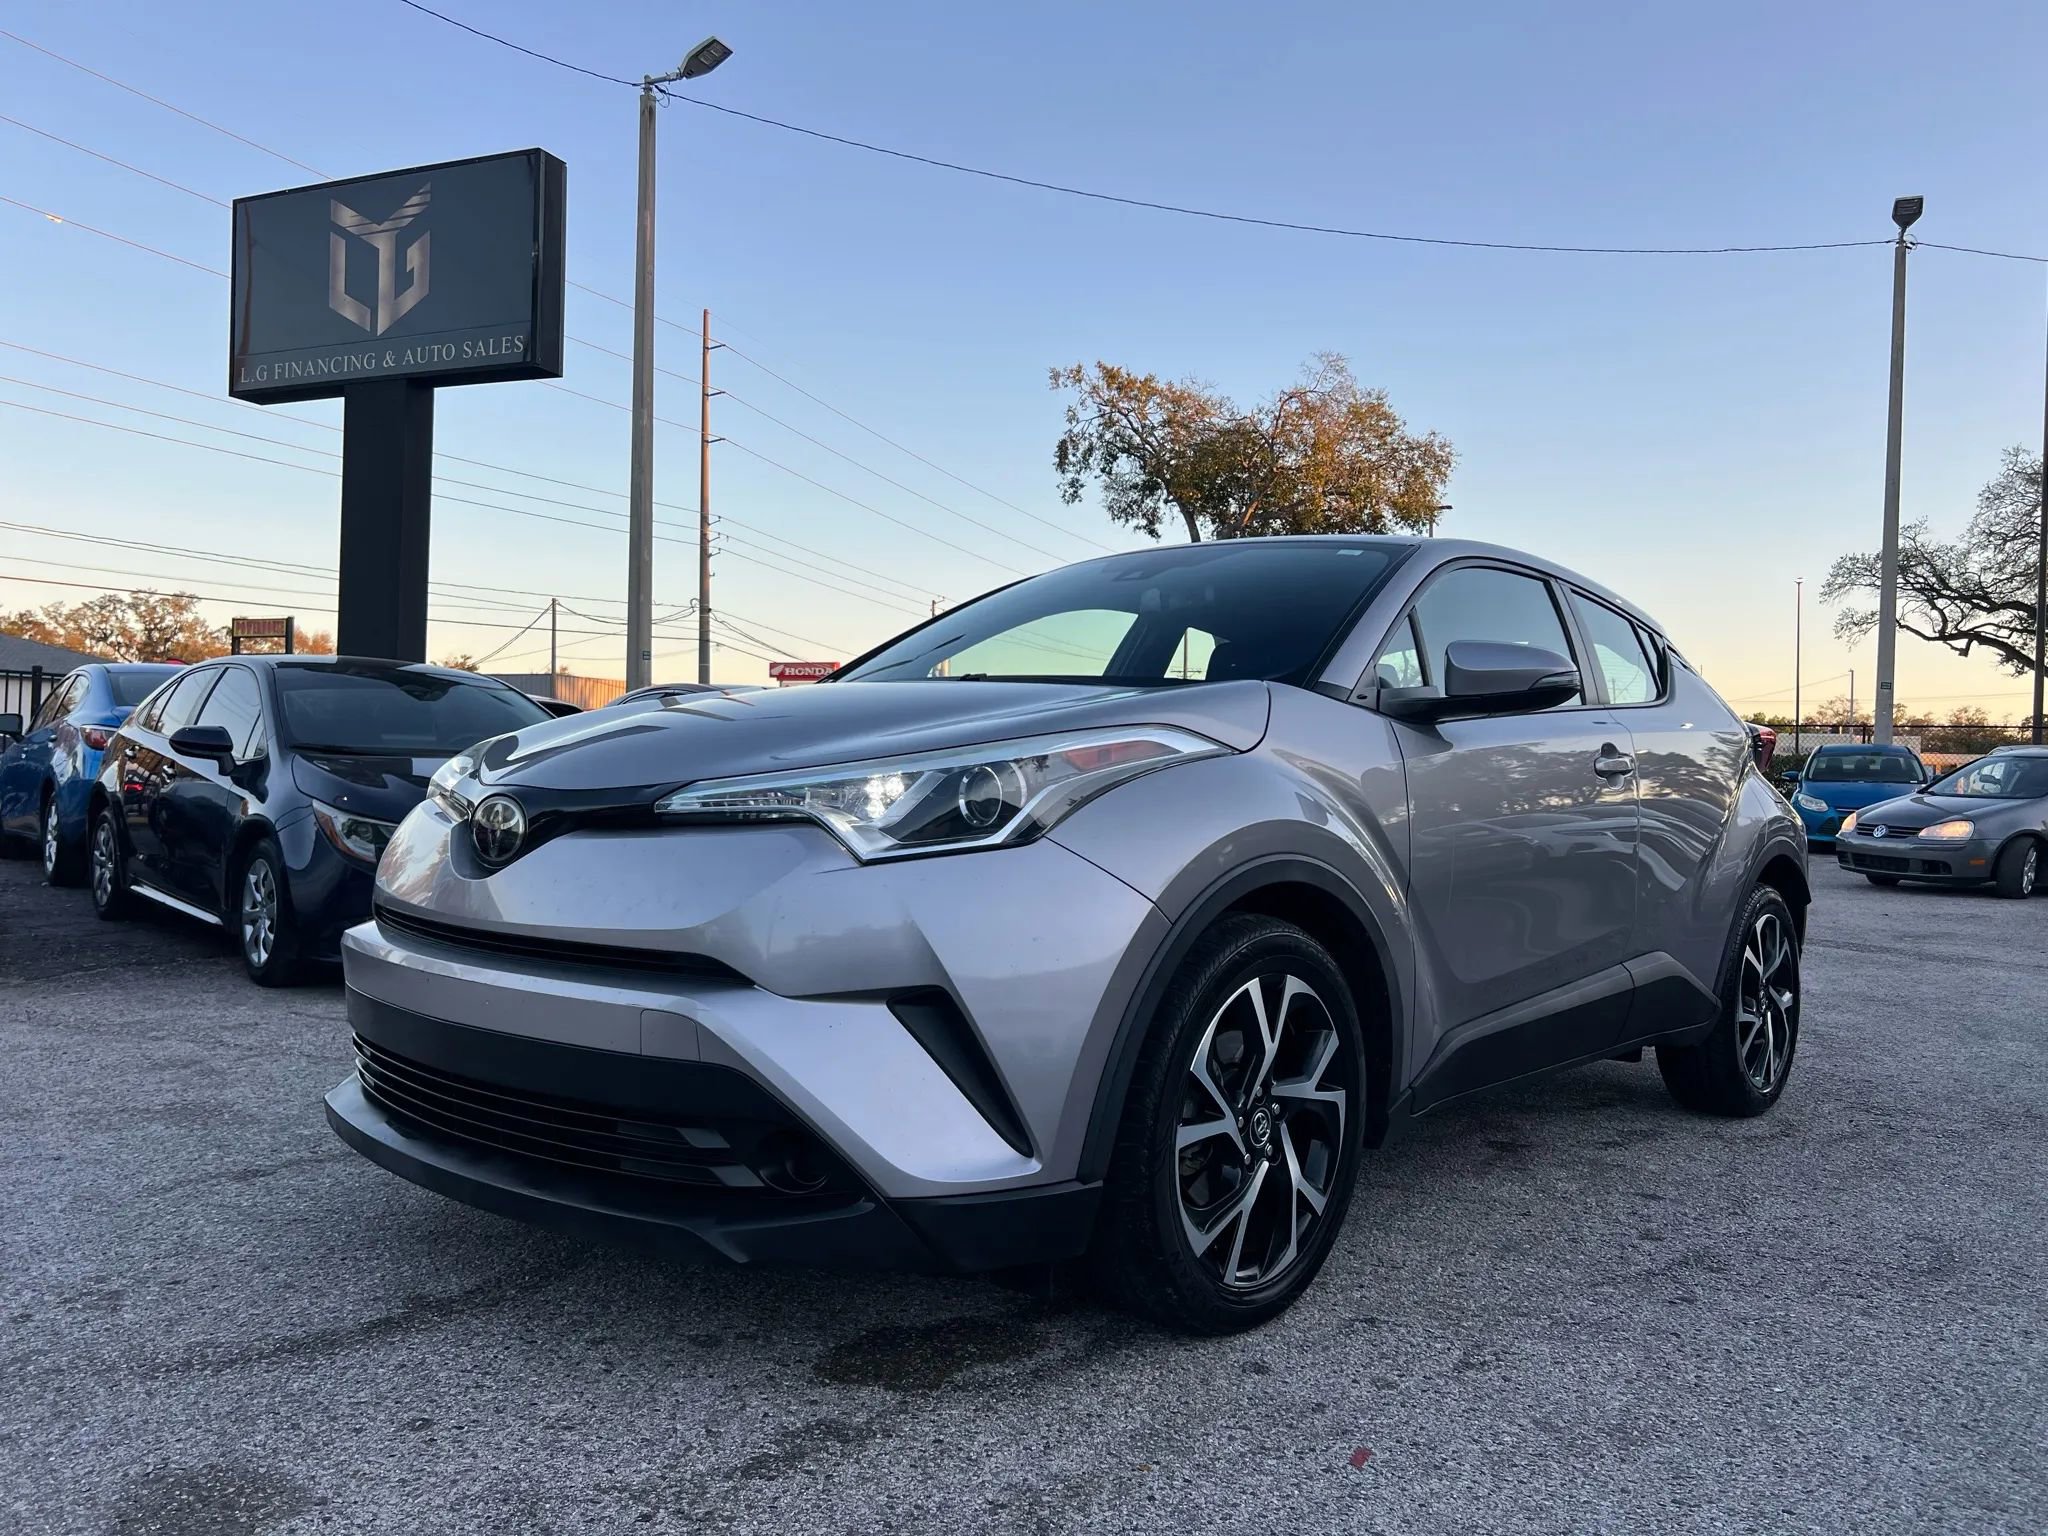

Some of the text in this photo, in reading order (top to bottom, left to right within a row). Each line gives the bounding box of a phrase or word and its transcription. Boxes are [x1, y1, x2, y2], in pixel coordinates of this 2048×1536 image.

[240, 335, 525, 383] L.G FINANCING & AUTO SALES
